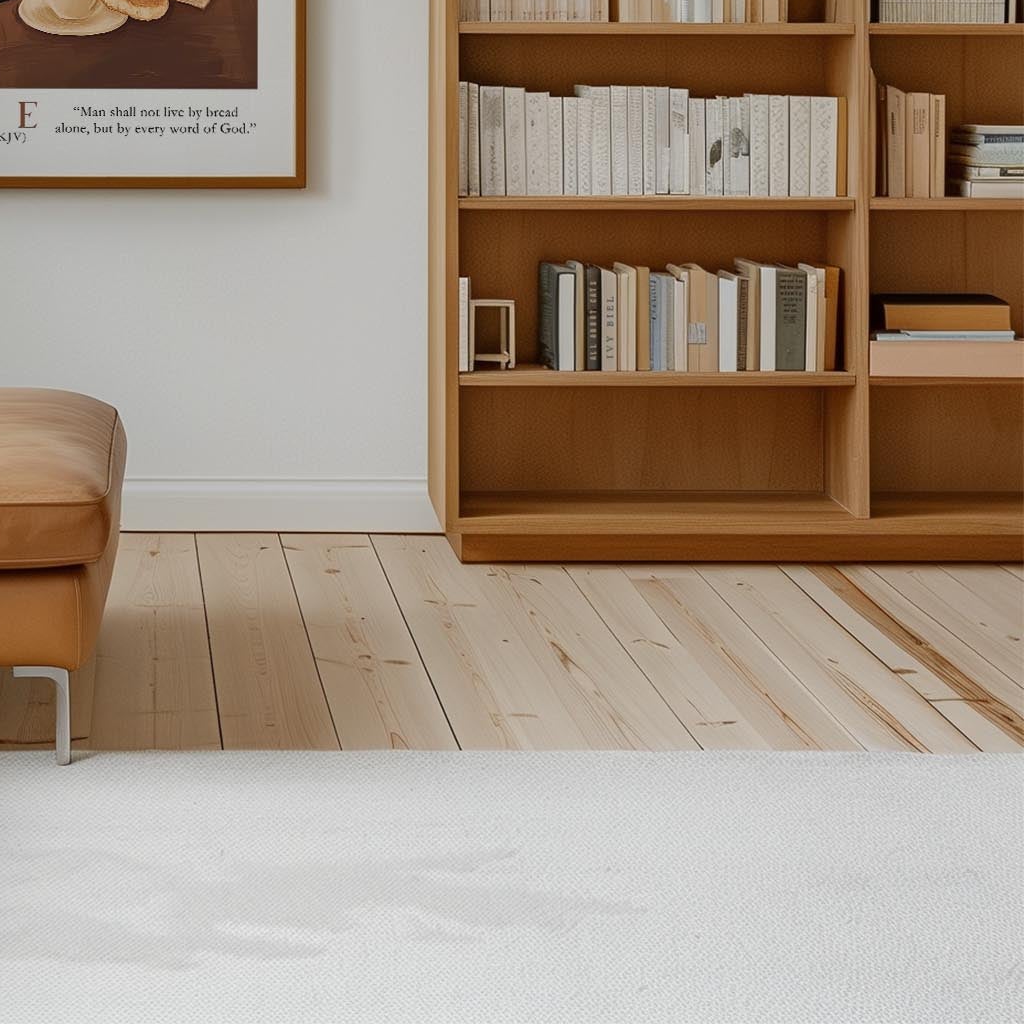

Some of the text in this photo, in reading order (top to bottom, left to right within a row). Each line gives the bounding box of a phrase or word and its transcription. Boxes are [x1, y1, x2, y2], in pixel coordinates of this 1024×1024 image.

[55, 122, 257, 136] alone, but by every word of God.”
[73, 106, 238, 120] “Man shall not live by bread
[589, 281, 598, 361] ALL ABOUT CATS
[606, 296, 615, 359] IVY BIEL
